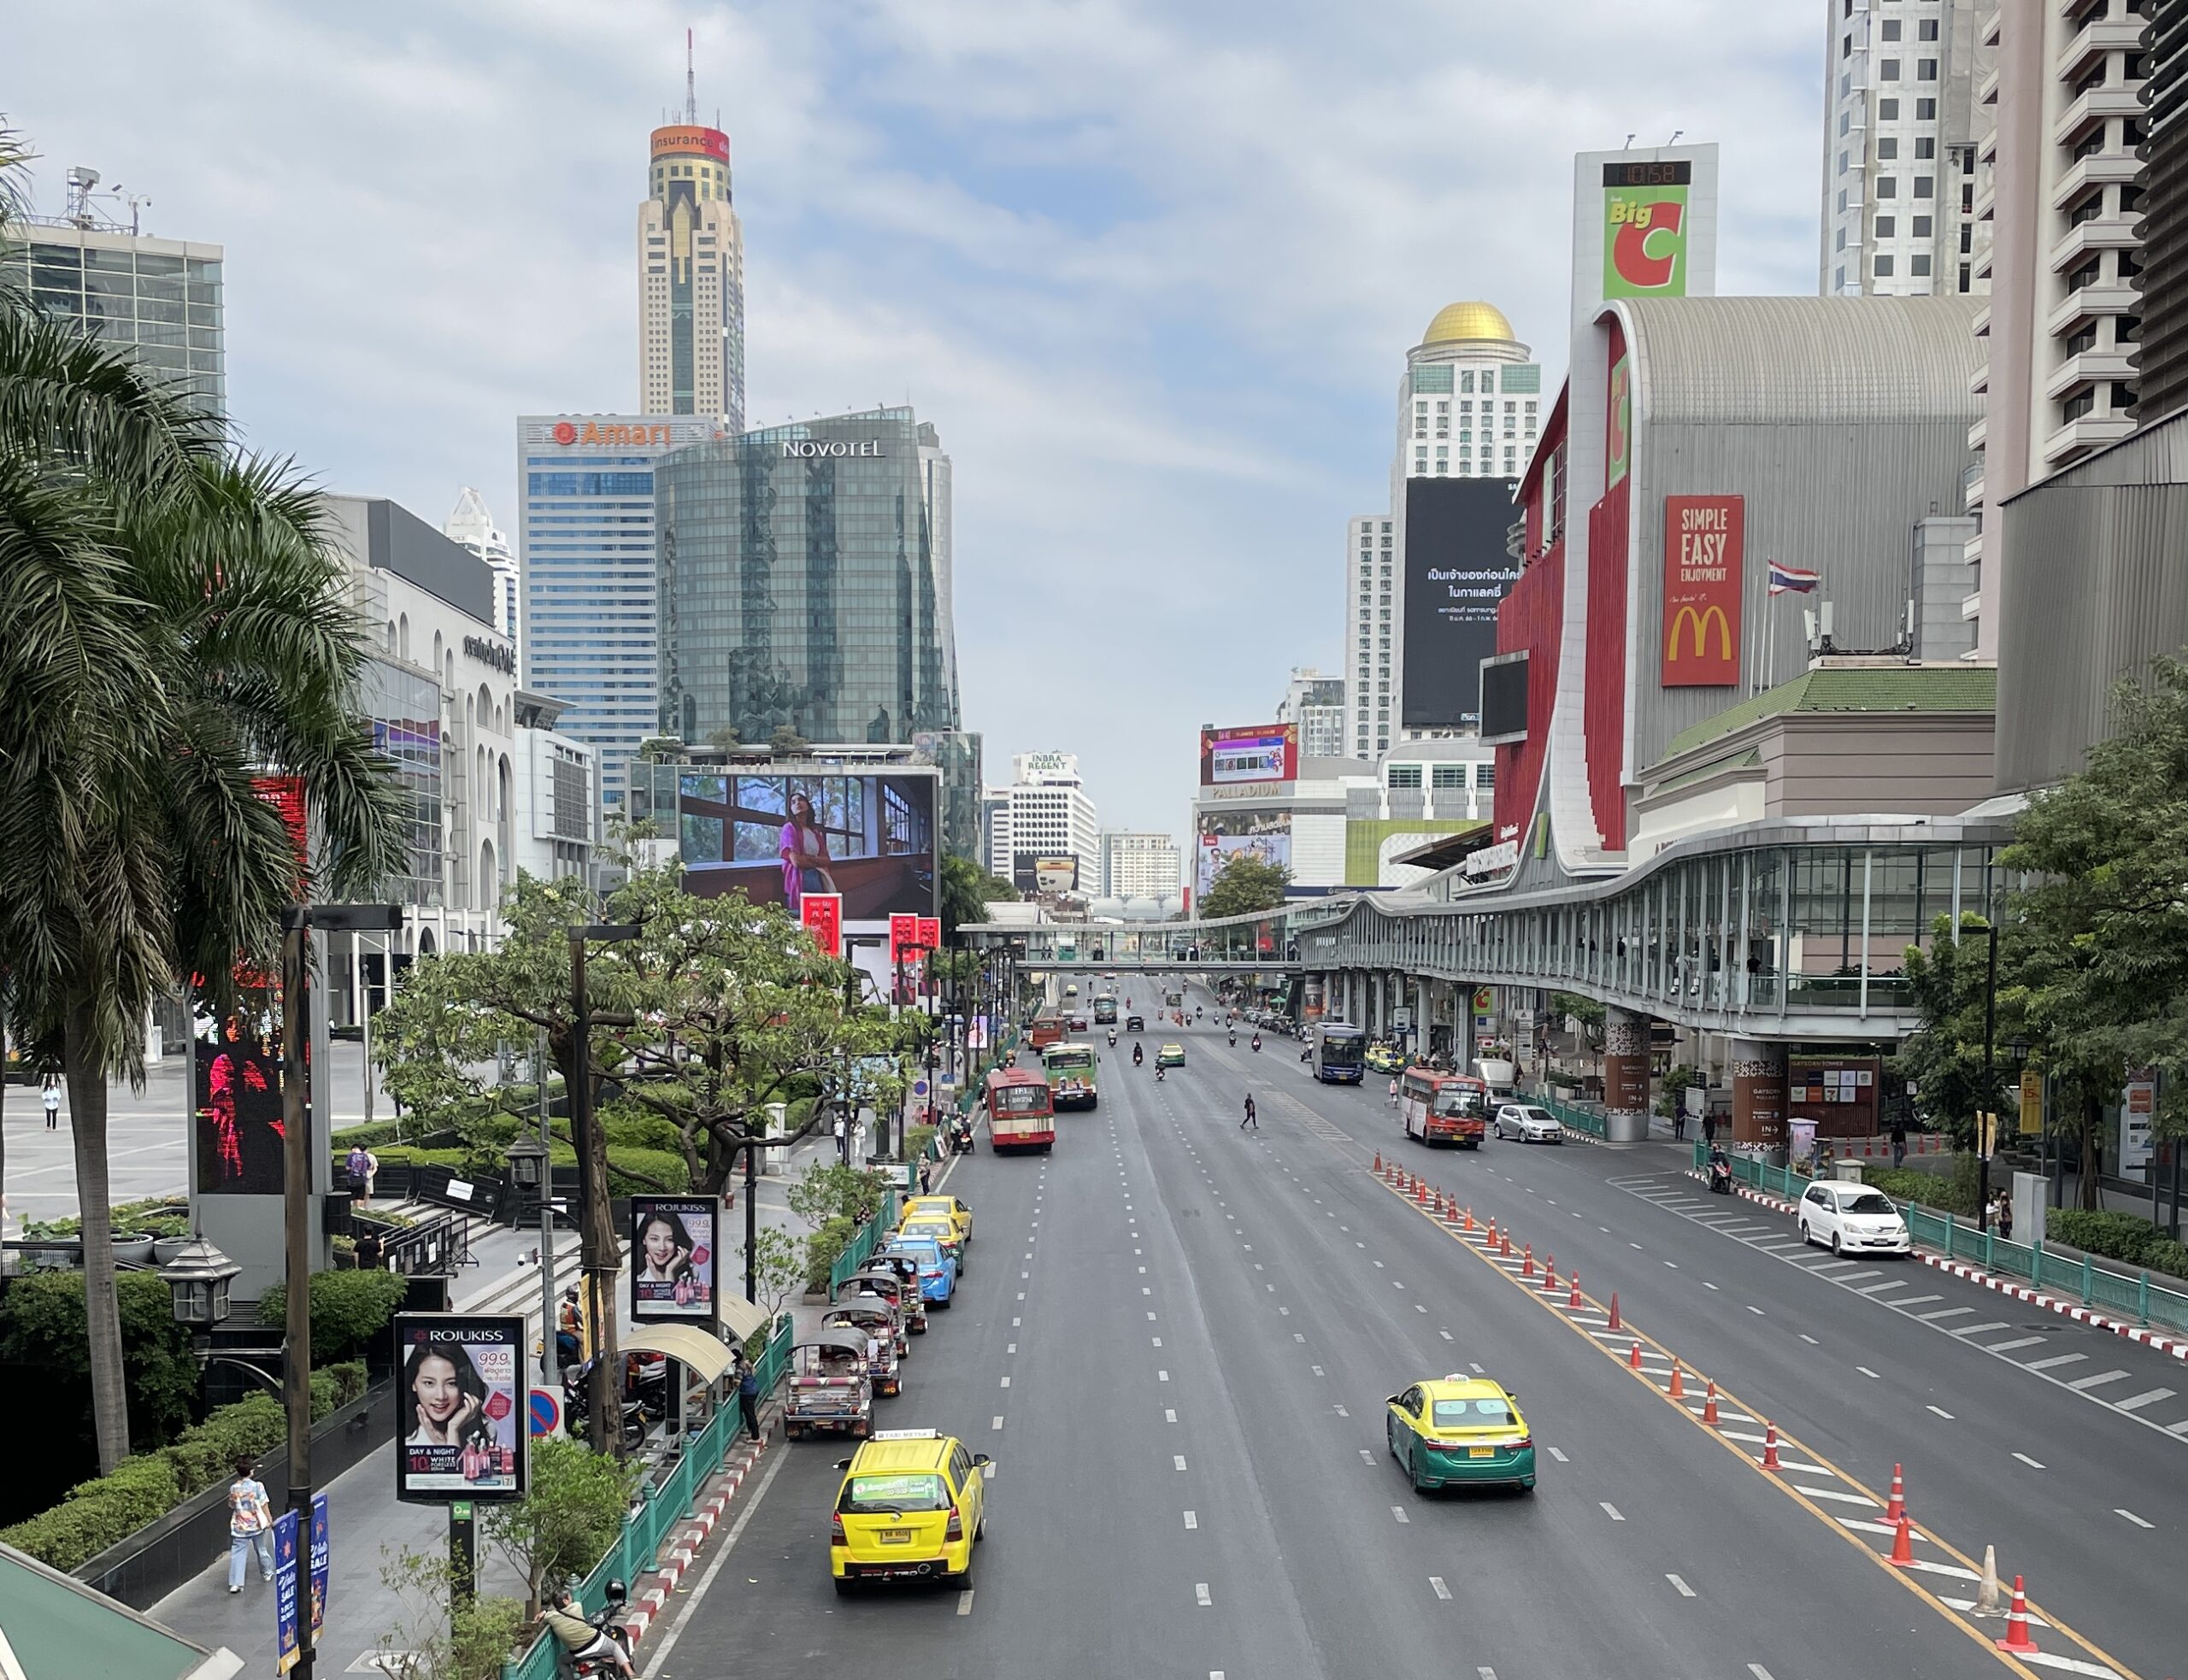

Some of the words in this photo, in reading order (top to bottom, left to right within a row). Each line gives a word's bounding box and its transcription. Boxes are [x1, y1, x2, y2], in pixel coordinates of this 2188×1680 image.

[655, 136, 714, 148] insurance
[1609, 202, 1653, 229] Big
[1614, 202, 1685, 288] C
[580, 422, 671, 445] Amari
[783, 440, 885, 458] NOVOTEL
[1681, 508, 1728, 531] SIMPLE
[1681, 533, 1727, 565] EASY
[1680, 567, 1727, 582] ENJOYMENT
[1212, 784, 1281, 798] PALLADIUM
[656, 1203, 706, 1212] ROJUKISS
[430, 1330, 503, 1342] ROJUKISS
